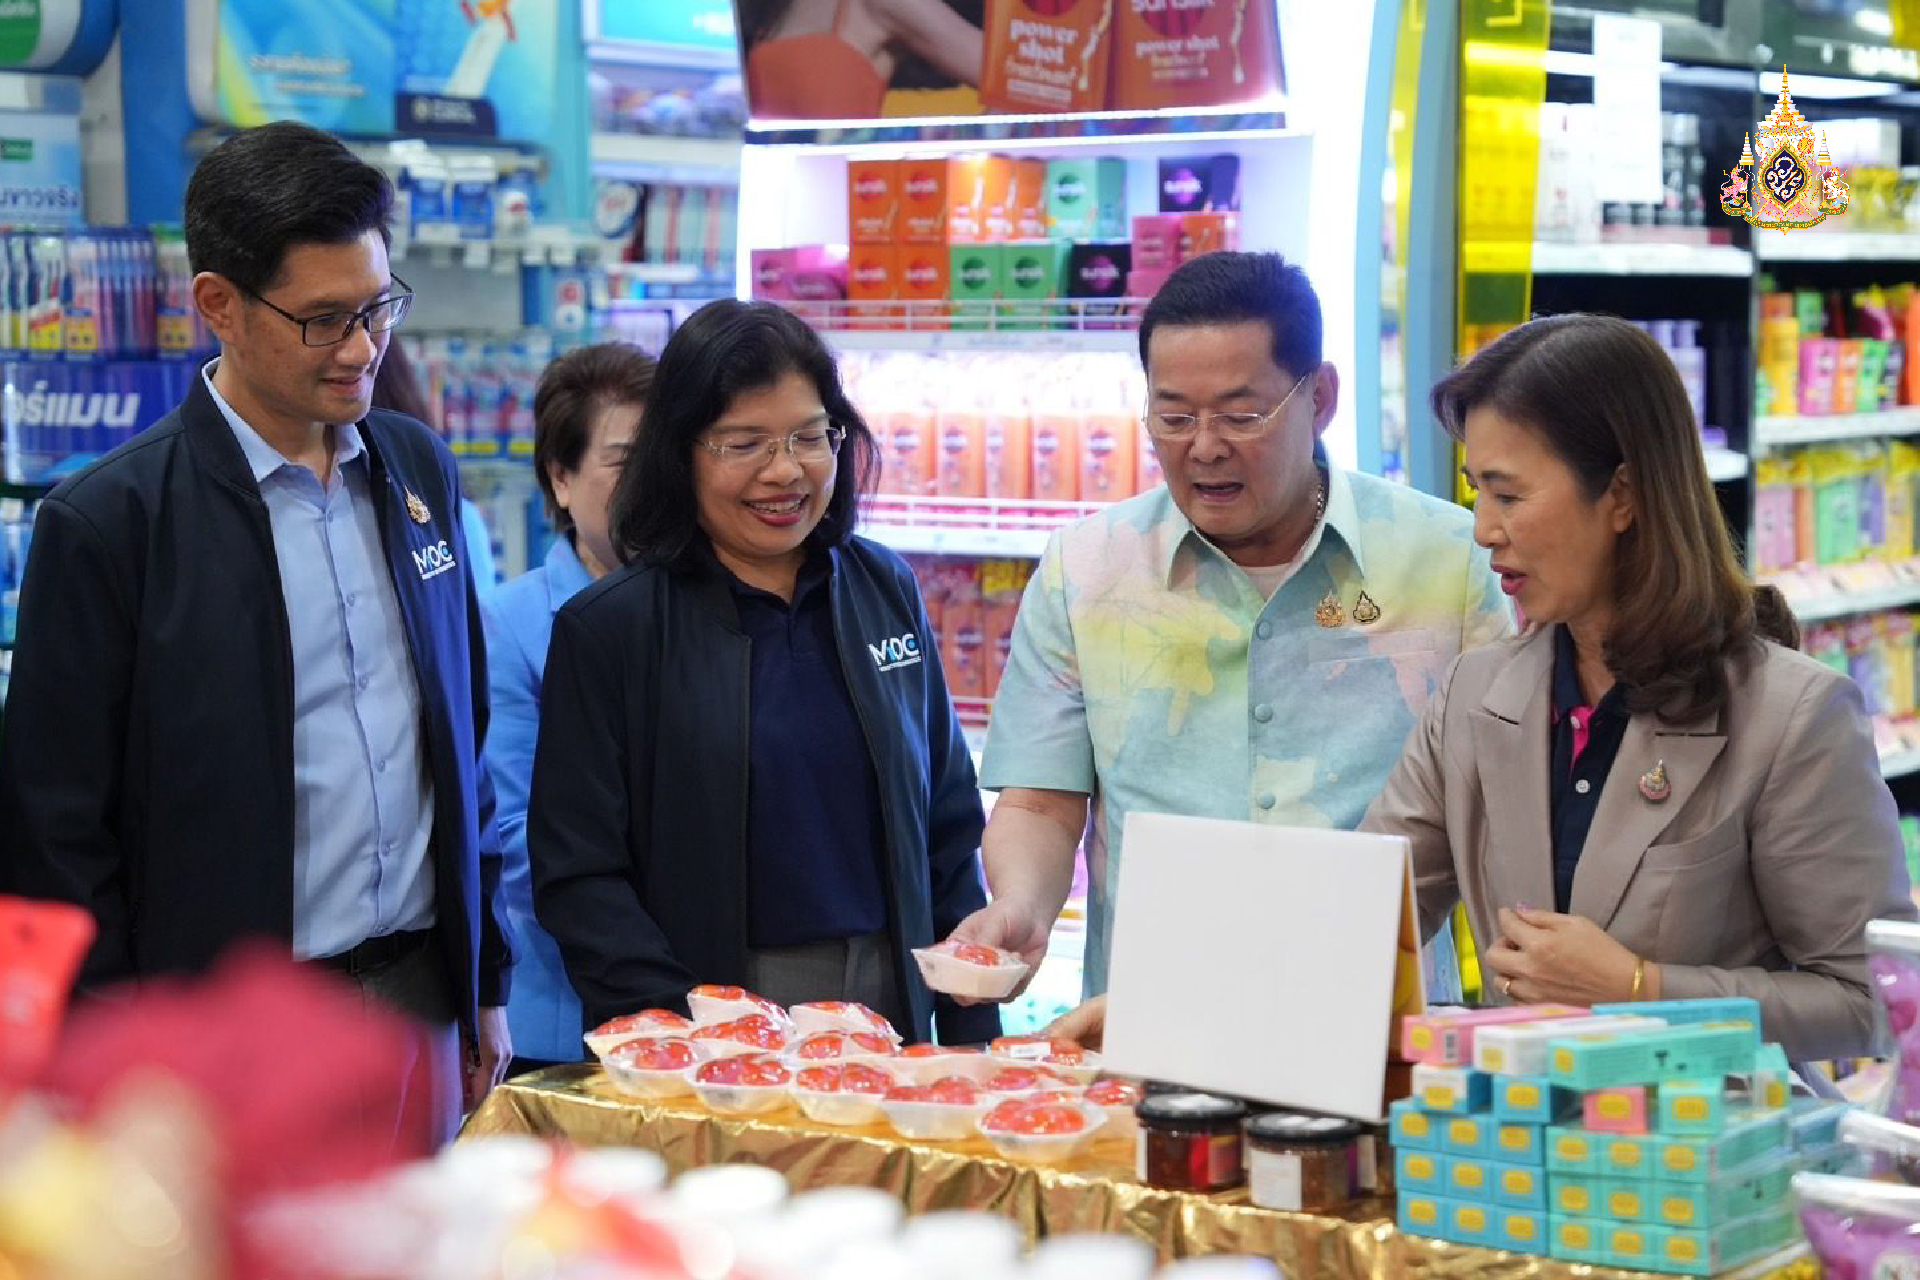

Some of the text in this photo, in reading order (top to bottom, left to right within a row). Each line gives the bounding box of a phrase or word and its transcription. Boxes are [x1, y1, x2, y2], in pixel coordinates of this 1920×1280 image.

[1010, 19, 1079, 45] power
[1019, 39, 1065, 64] shot
[1135, 35, 1220, 59] power shot
[868, 633, 919, 667] MOC
